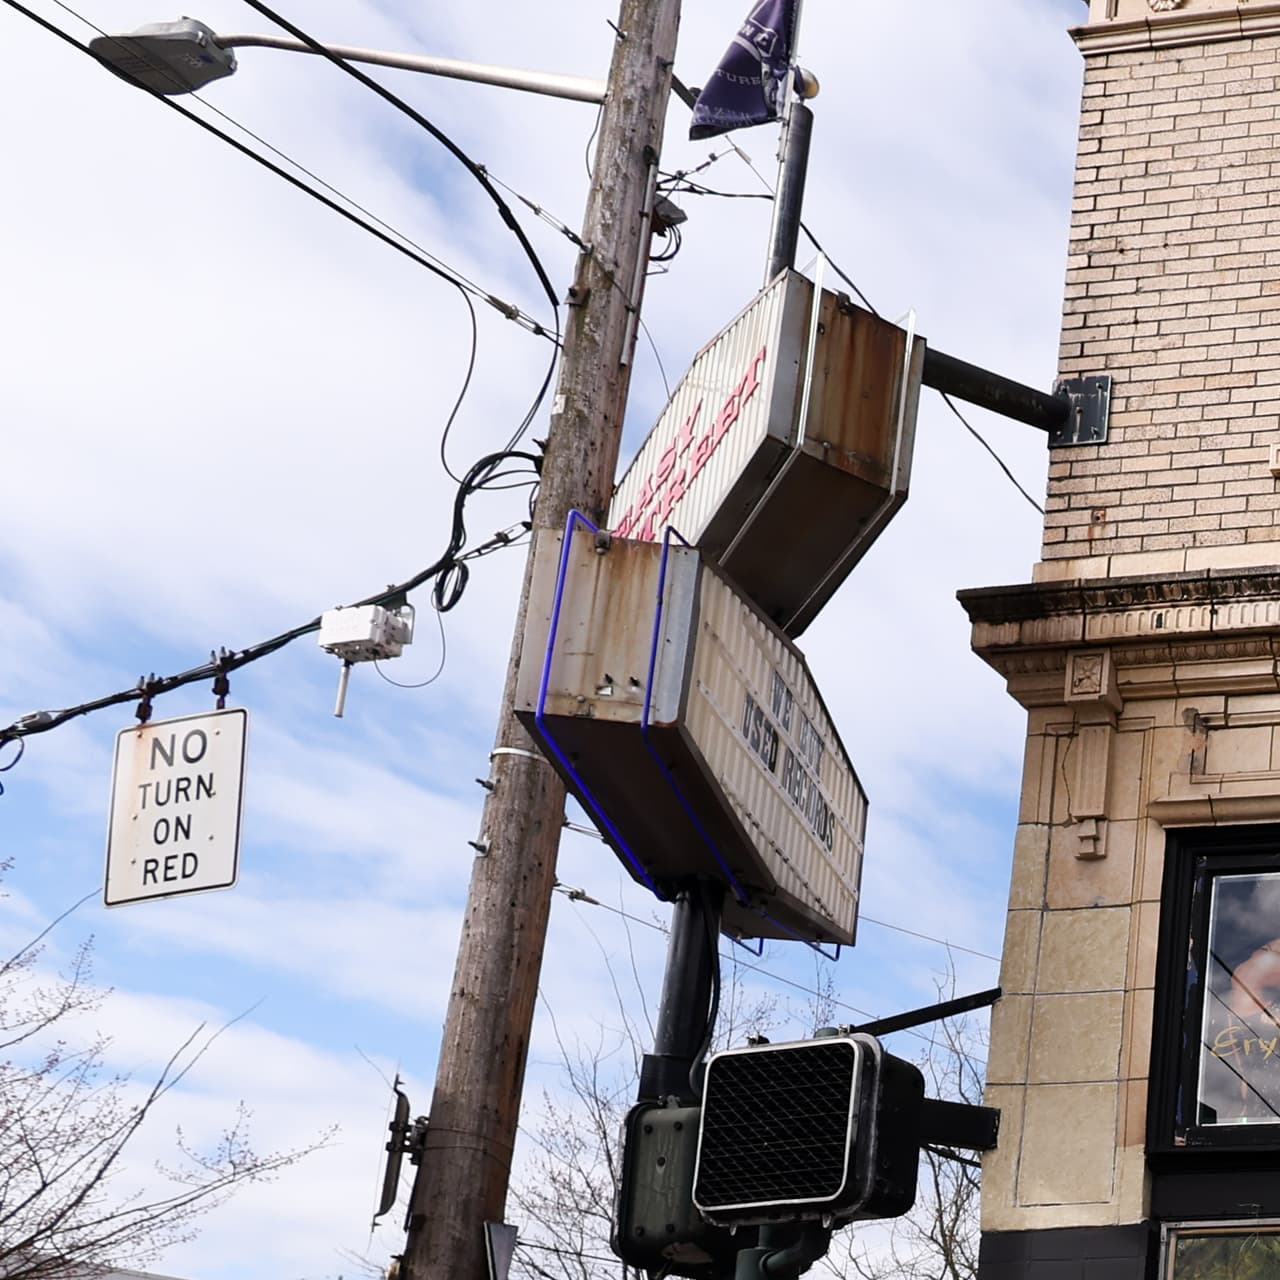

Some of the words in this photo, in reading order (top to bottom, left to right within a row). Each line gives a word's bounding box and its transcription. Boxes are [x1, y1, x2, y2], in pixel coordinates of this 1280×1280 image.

[150, 729, 208, 770] NO
[799, 710, 825, 779] BUY
[742, 690, 779, 774] USED
[781, 750, 836, 852] RECORDS
[138, 772, 215, 810] TURN
[153, 814, 193, 845] ON
[143, 852, 200, 887] RED
